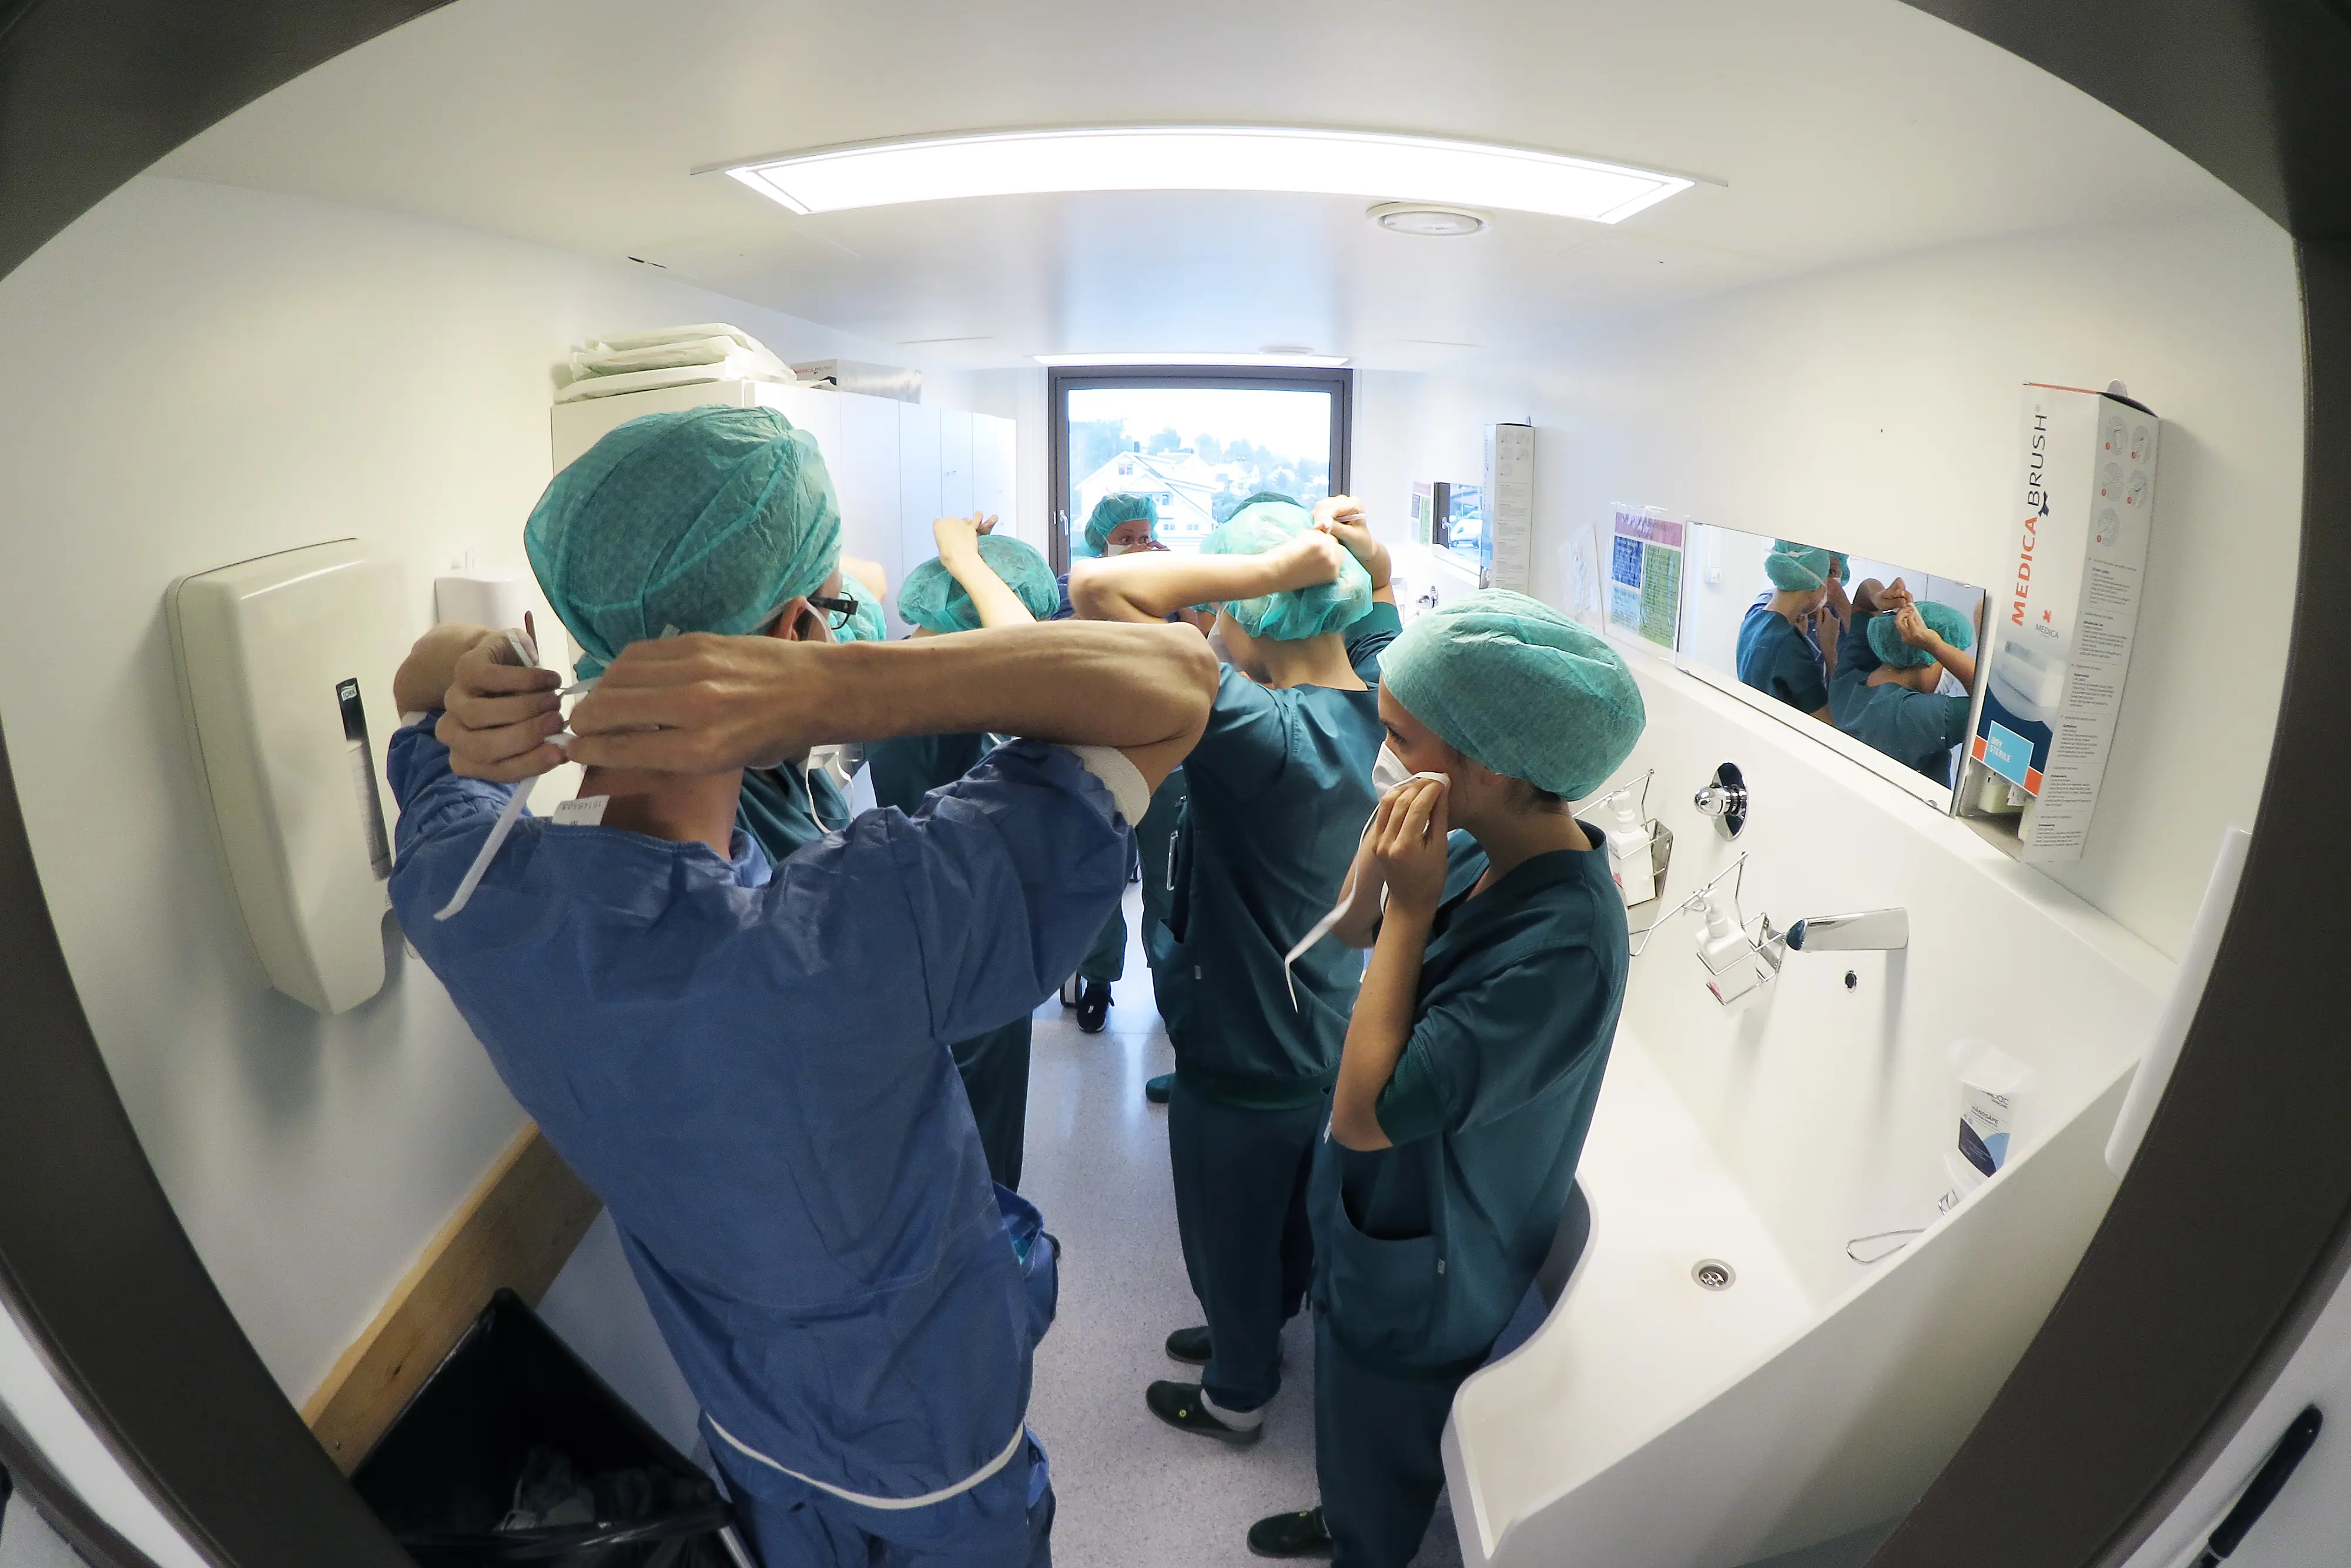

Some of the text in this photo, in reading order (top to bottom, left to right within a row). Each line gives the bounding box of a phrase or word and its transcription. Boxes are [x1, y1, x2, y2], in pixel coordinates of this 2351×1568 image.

[2011, 517, 2038, 626] MEDICA
[2035, 624, 2059, 639] MEDICA
[1991, 736, 2003, 748] DRY
[1990, 745, 2011, 762] STERILE
